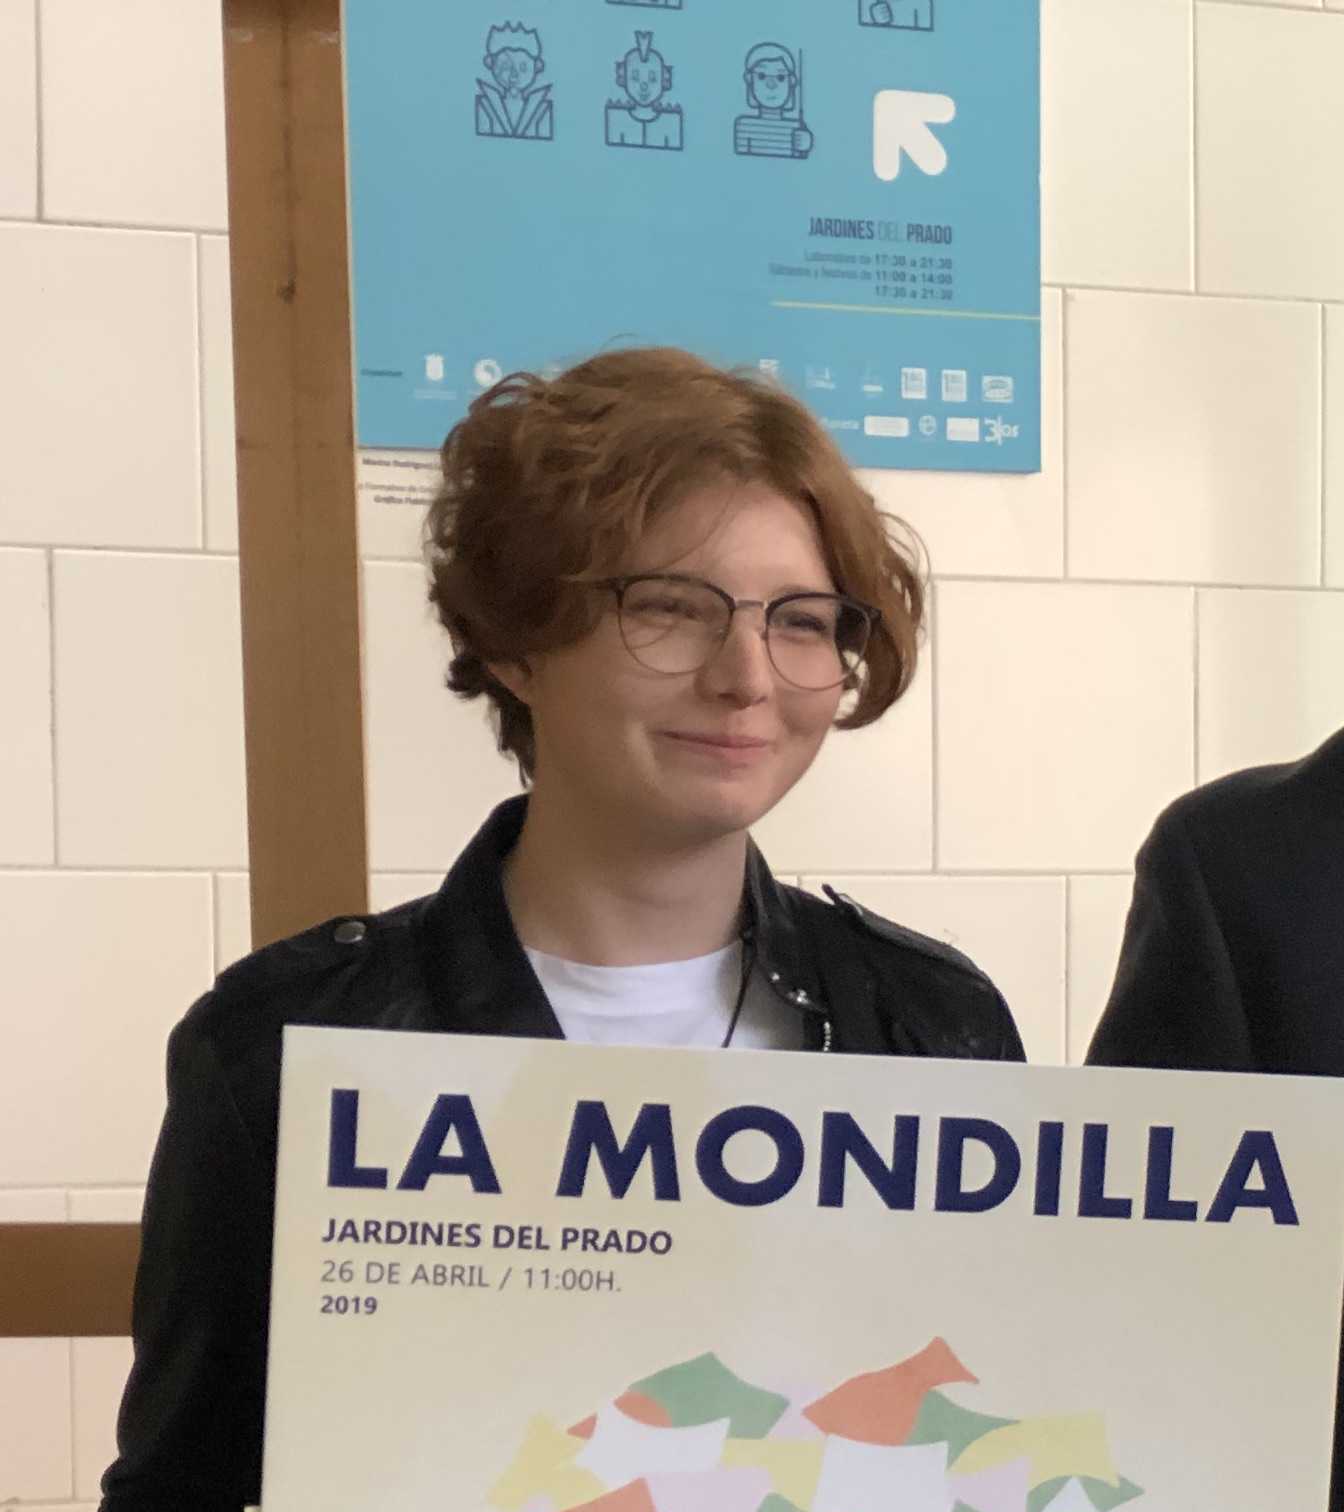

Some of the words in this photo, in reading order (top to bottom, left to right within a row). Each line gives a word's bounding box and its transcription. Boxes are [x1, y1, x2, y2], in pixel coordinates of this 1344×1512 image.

[808, 217, 874, 240] JARDINES
[878, 220, 904, 242] DEL
[906, 223, 953, 244] PRADO
[327, 1089, 502, 1195] LA
[555, 1100, 1300, 1226] MONDILLA
[321, 1218, 481, 1249] JARDINES
[493, 1225, 550, 1251] DEL
[560, 1228, 673, 1255] PRADO
[321, 1260, 354, 1284] 26
[365, 1262, 401, 1285] DE
[411, 1263, 490, 1289] ABRIL
[499, 1266, 513, 1291] /
[522, 1268, 622, 1293] 11:00H.
[320, 1296, 377, 1316] 2019
